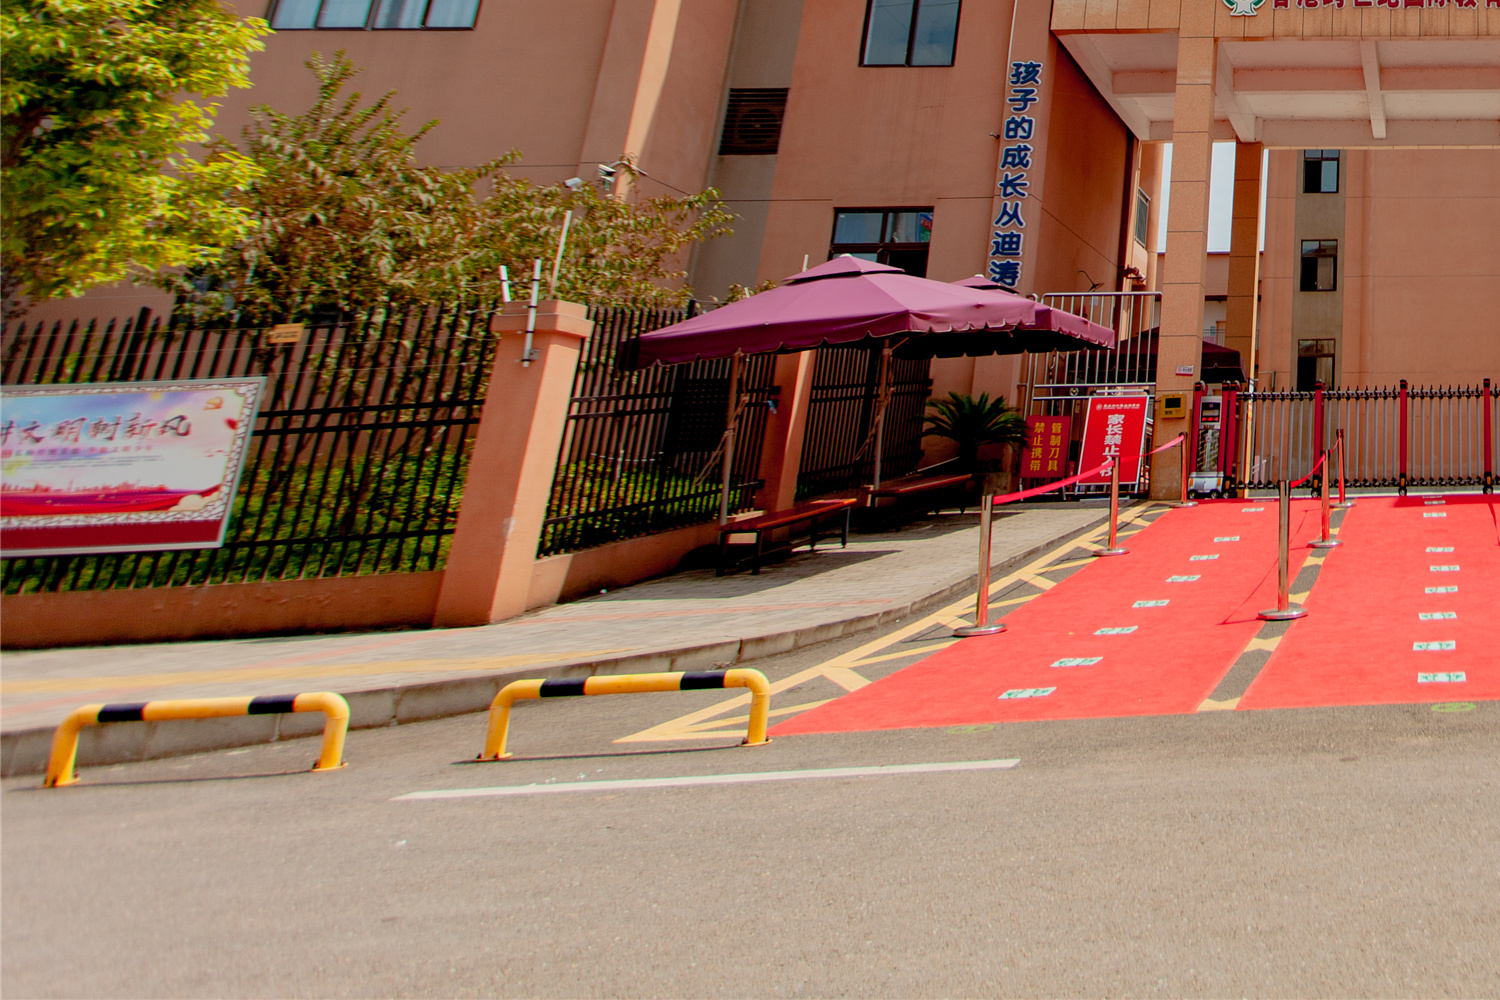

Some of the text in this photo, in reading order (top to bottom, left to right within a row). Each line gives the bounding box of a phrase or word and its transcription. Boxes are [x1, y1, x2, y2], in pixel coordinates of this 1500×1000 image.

[989, 61, 1042, 287] 孩子的成长从迪涛
[1029, 421, 1045, 471] 禁止携带
[1047, 422, 1062, 471] 管制刀具
